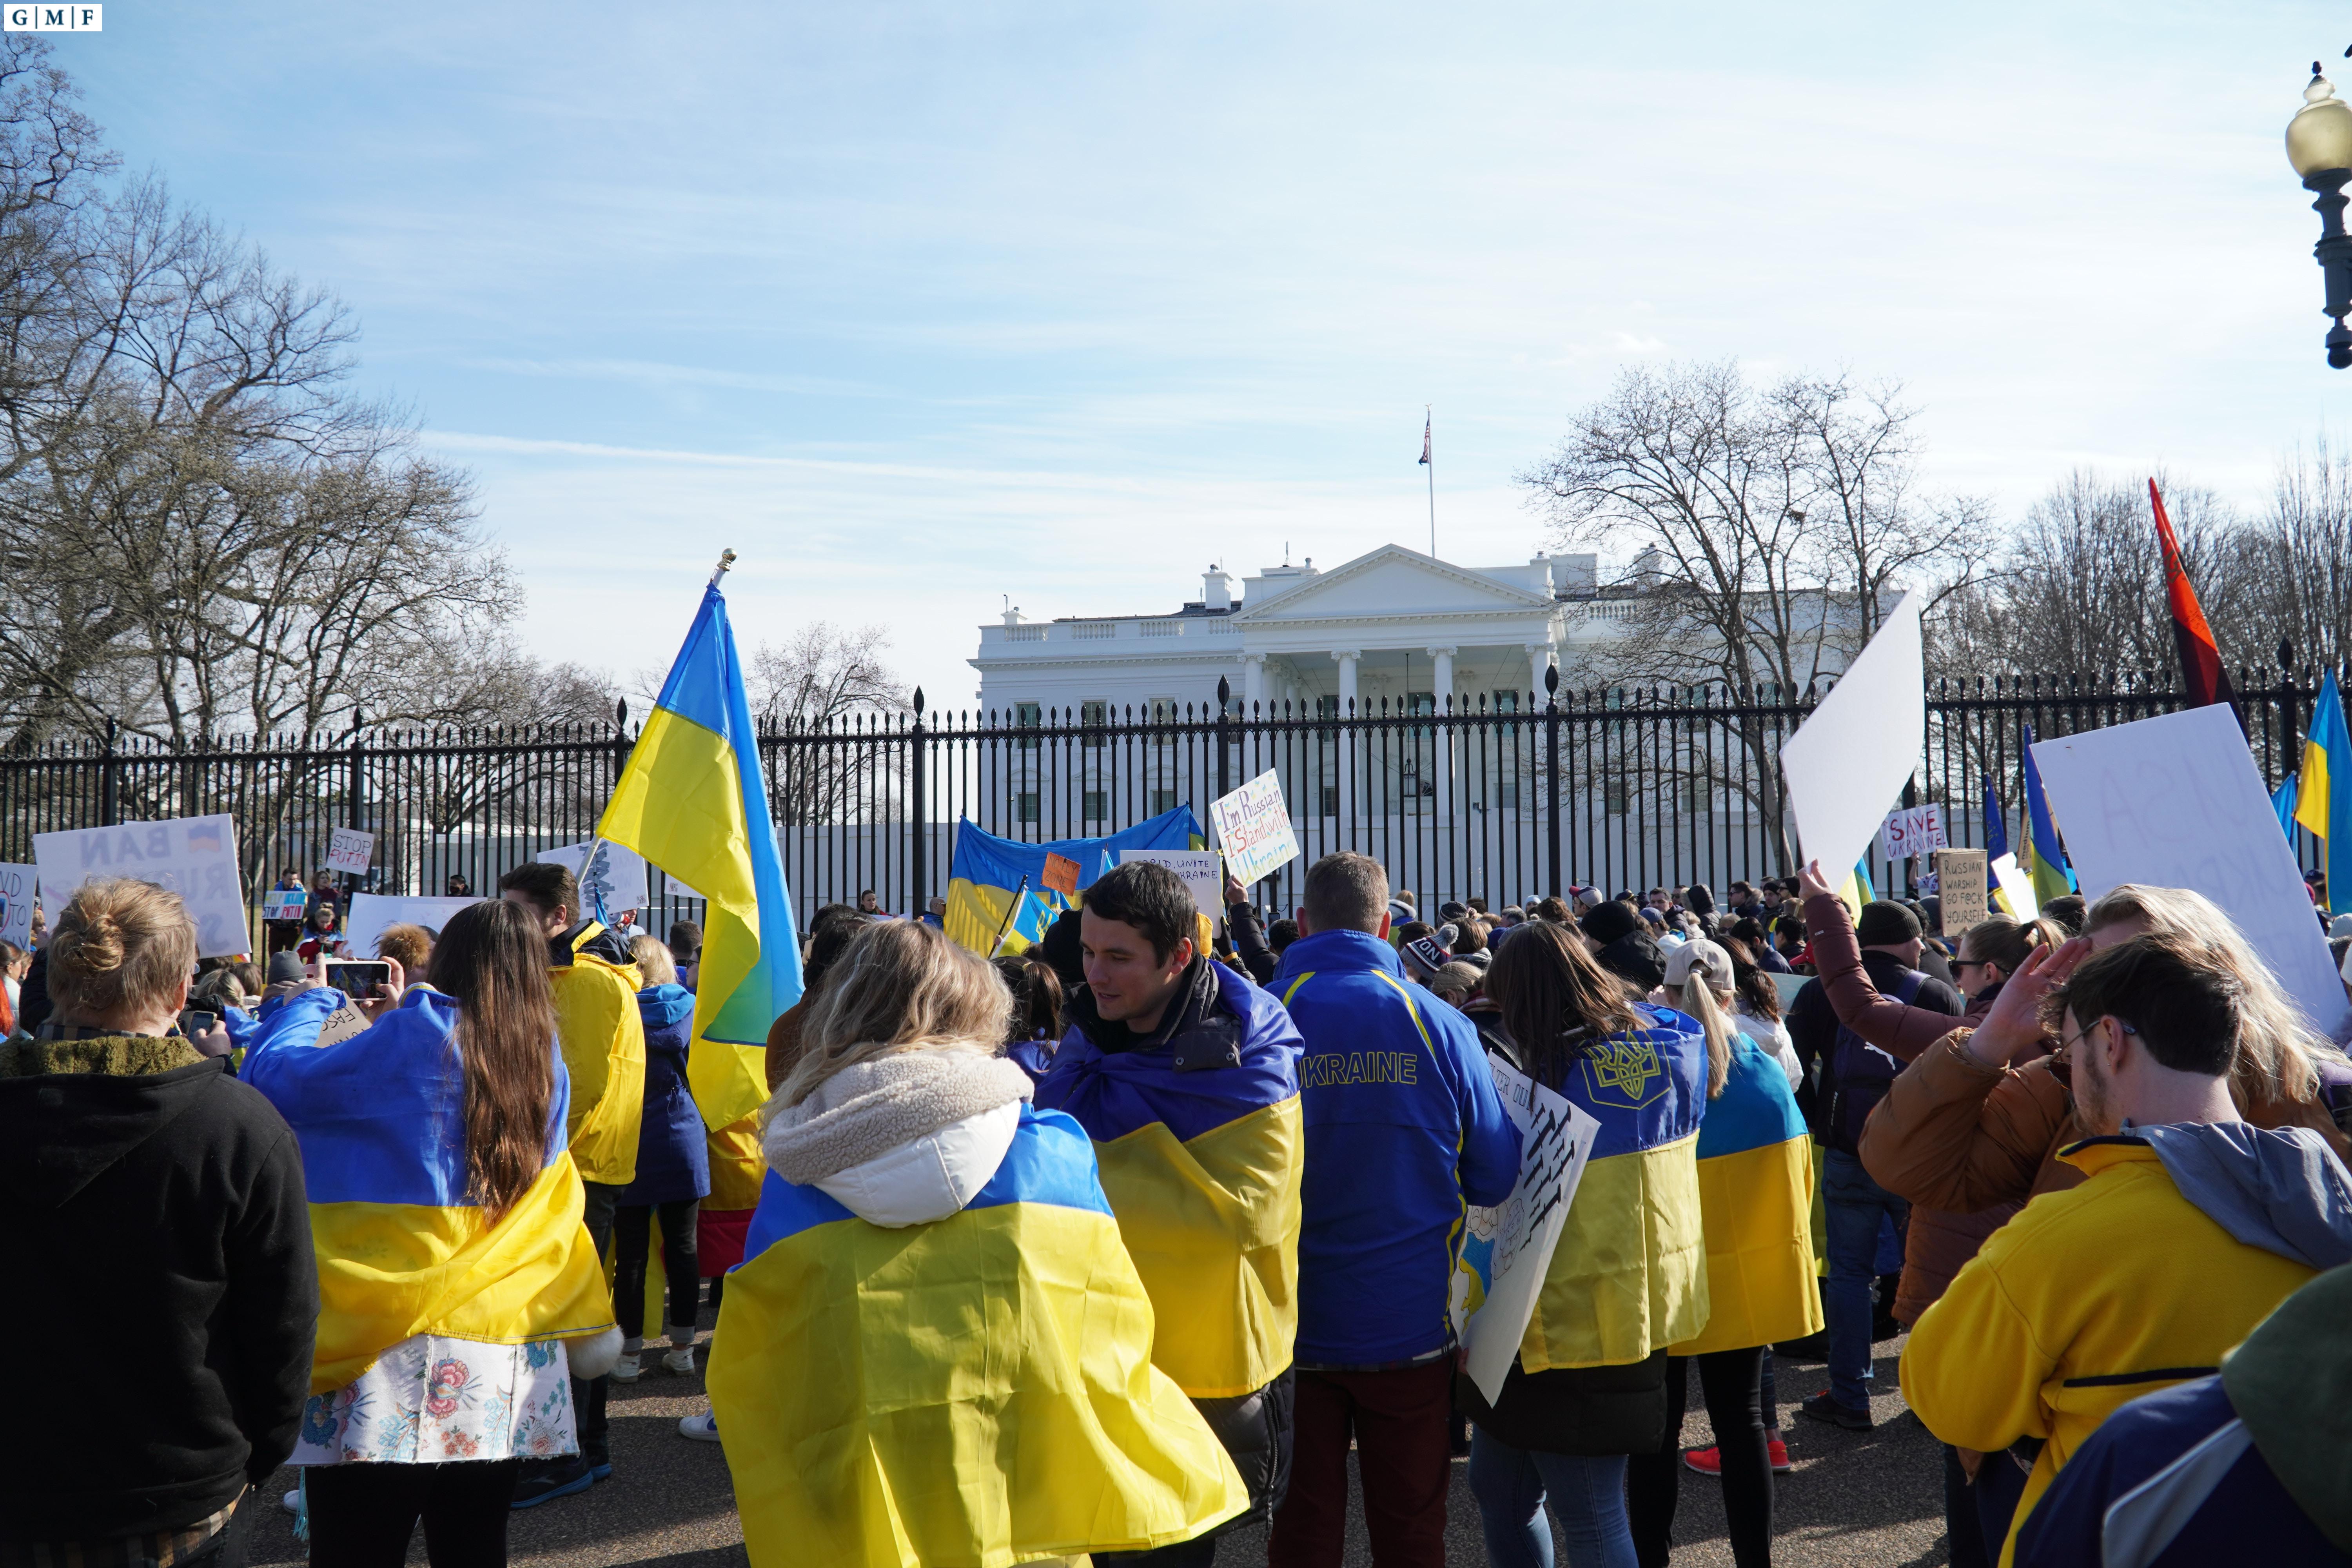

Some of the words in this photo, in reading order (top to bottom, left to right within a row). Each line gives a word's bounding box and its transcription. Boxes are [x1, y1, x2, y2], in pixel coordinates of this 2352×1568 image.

[1218, 801, 1241, 833] I'm
[1238, 789, 1281, 820] Russian
[1890, 810, 1940, 841] SAVE
[334, 835, 371, 853] STOP
[330, 849, 369, 867] PUTIN
[1048, 856, 1078, 875] NO-FLY
[1044, 870, 1070, 889] ZONE
[1946, 893, 1957, 905] GO
[1960, 892, 1984, 905] F@CK
[262, 906, 279, 918] STOP
[1946, 909, 1985, 924] YOURSELF
[323, 1008, 356, 1031] FASC
